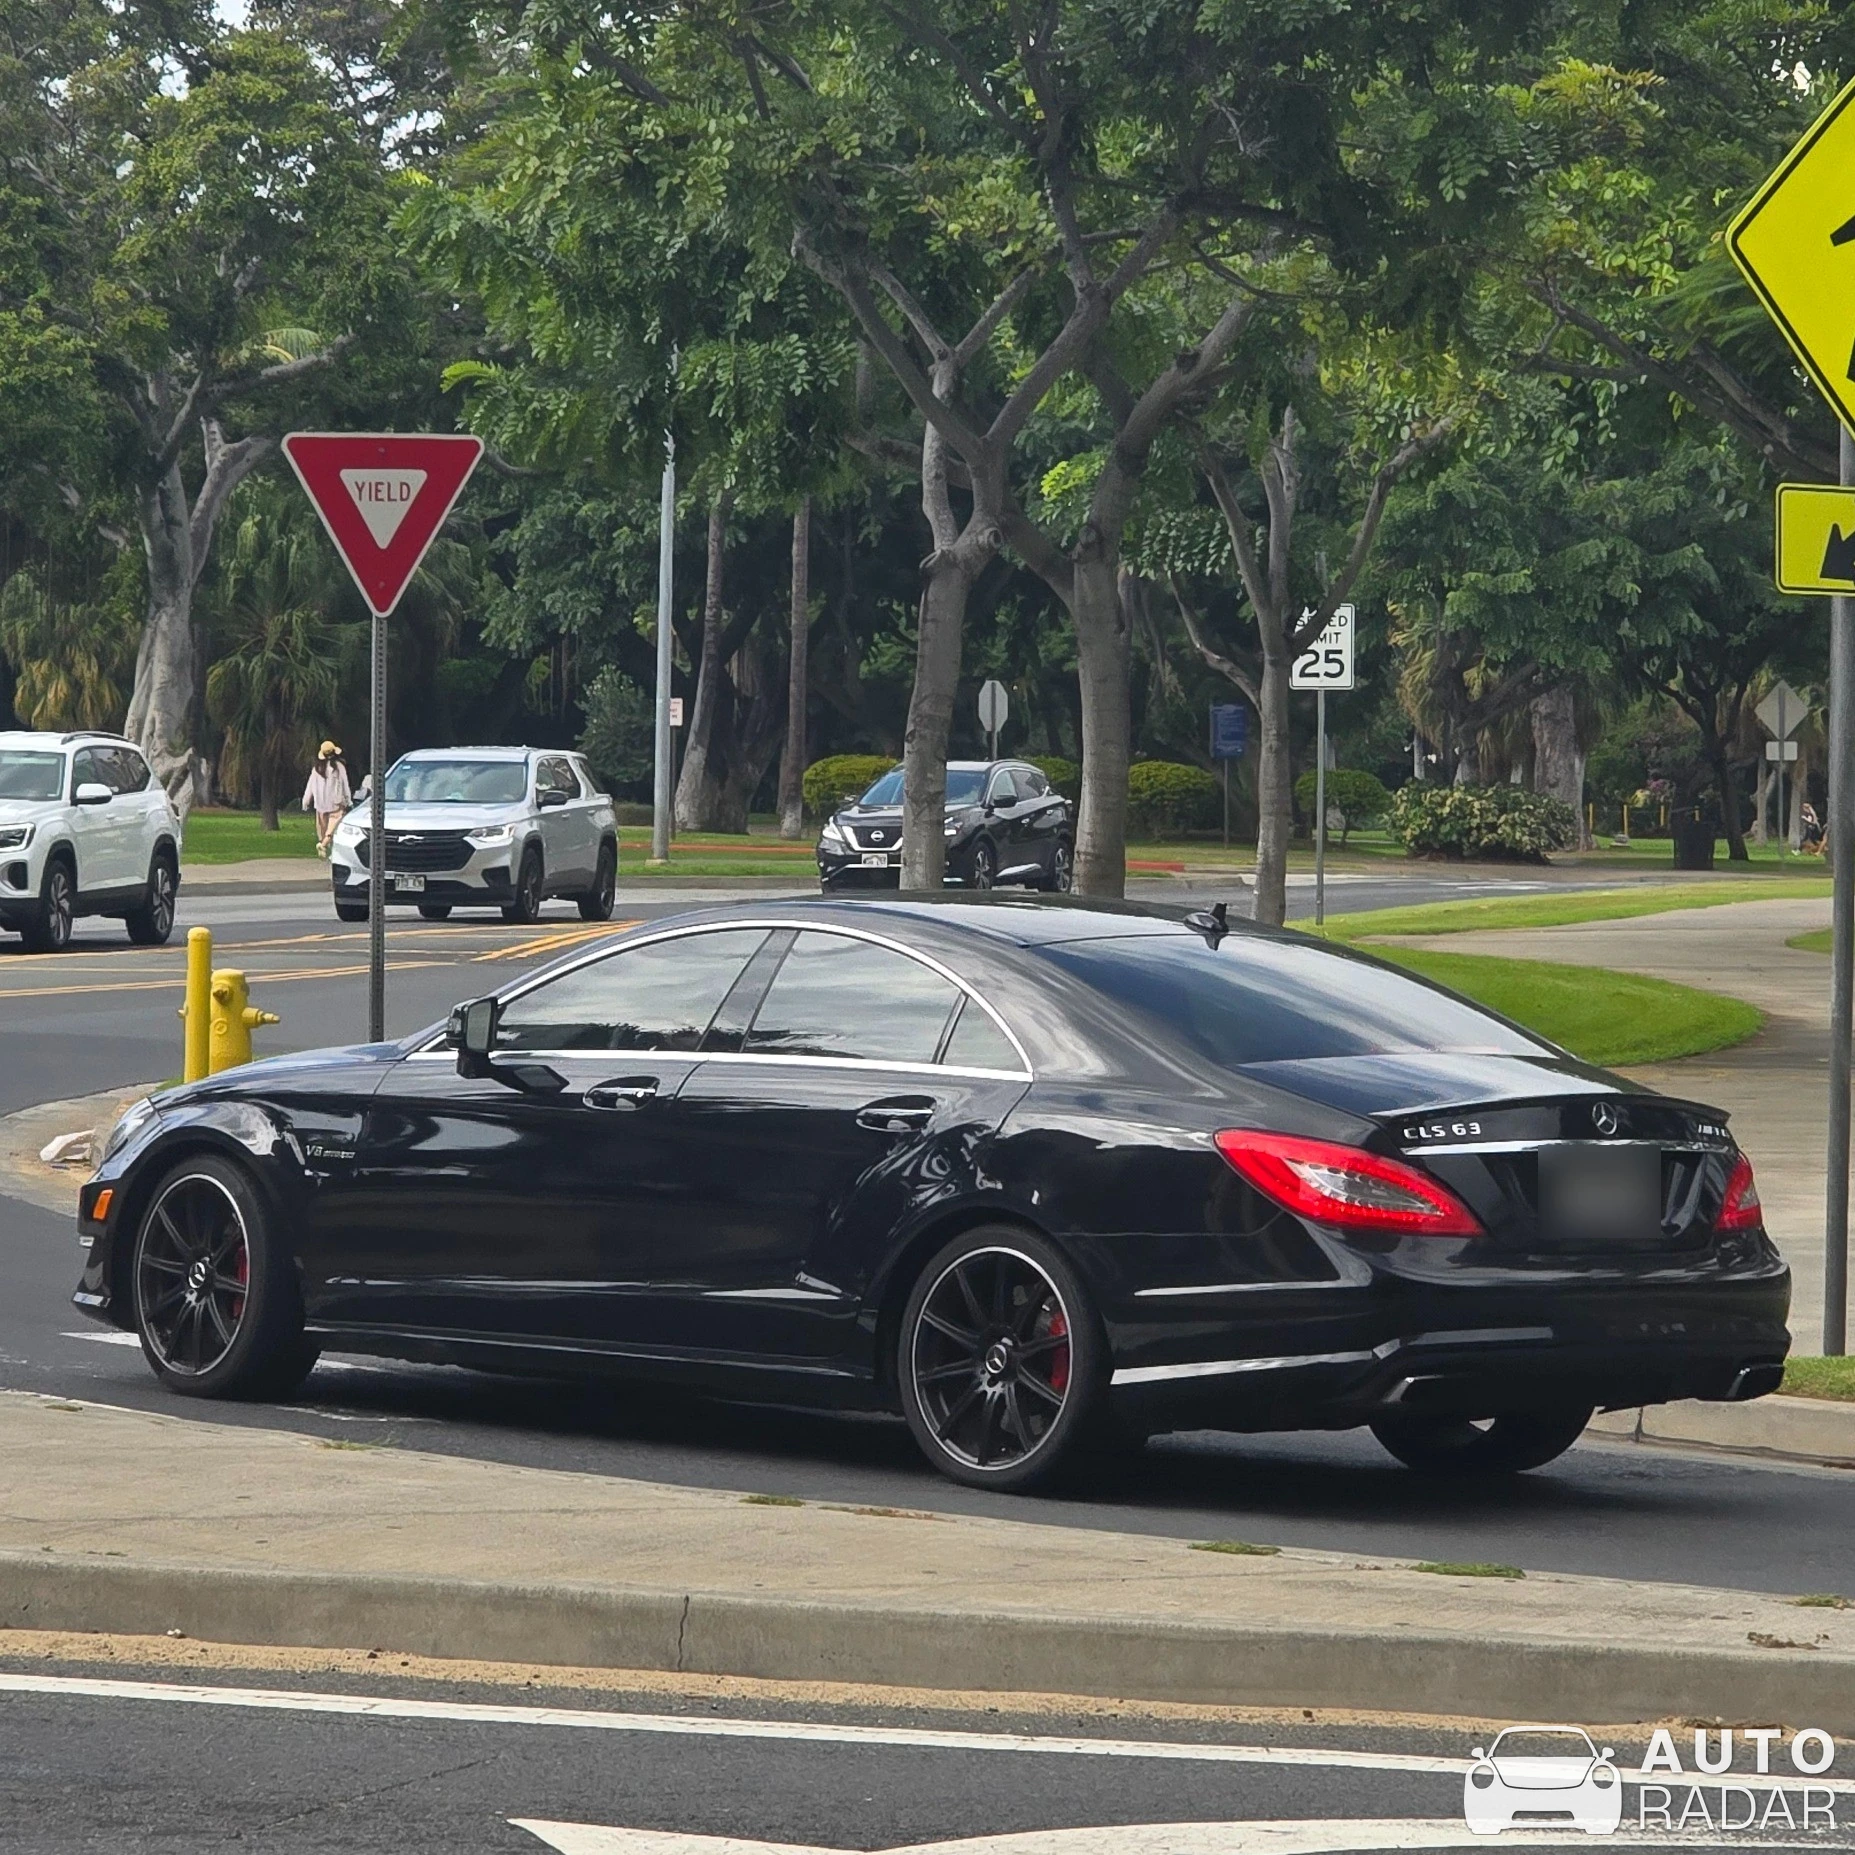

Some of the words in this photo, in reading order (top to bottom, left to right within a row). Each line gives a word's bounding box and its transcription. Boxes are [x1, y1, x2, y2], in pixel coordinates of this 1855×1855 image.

[355, 481, 411, 502] YIELD
[1297, 615, 1348, 628] SED
[1299, 649, 1345, 679] 25
[1403, 1125, 1447, 1139] CLS
[1451, 1121, 1482, 1136] 63
[306, 1144, 324, 1157] V8
